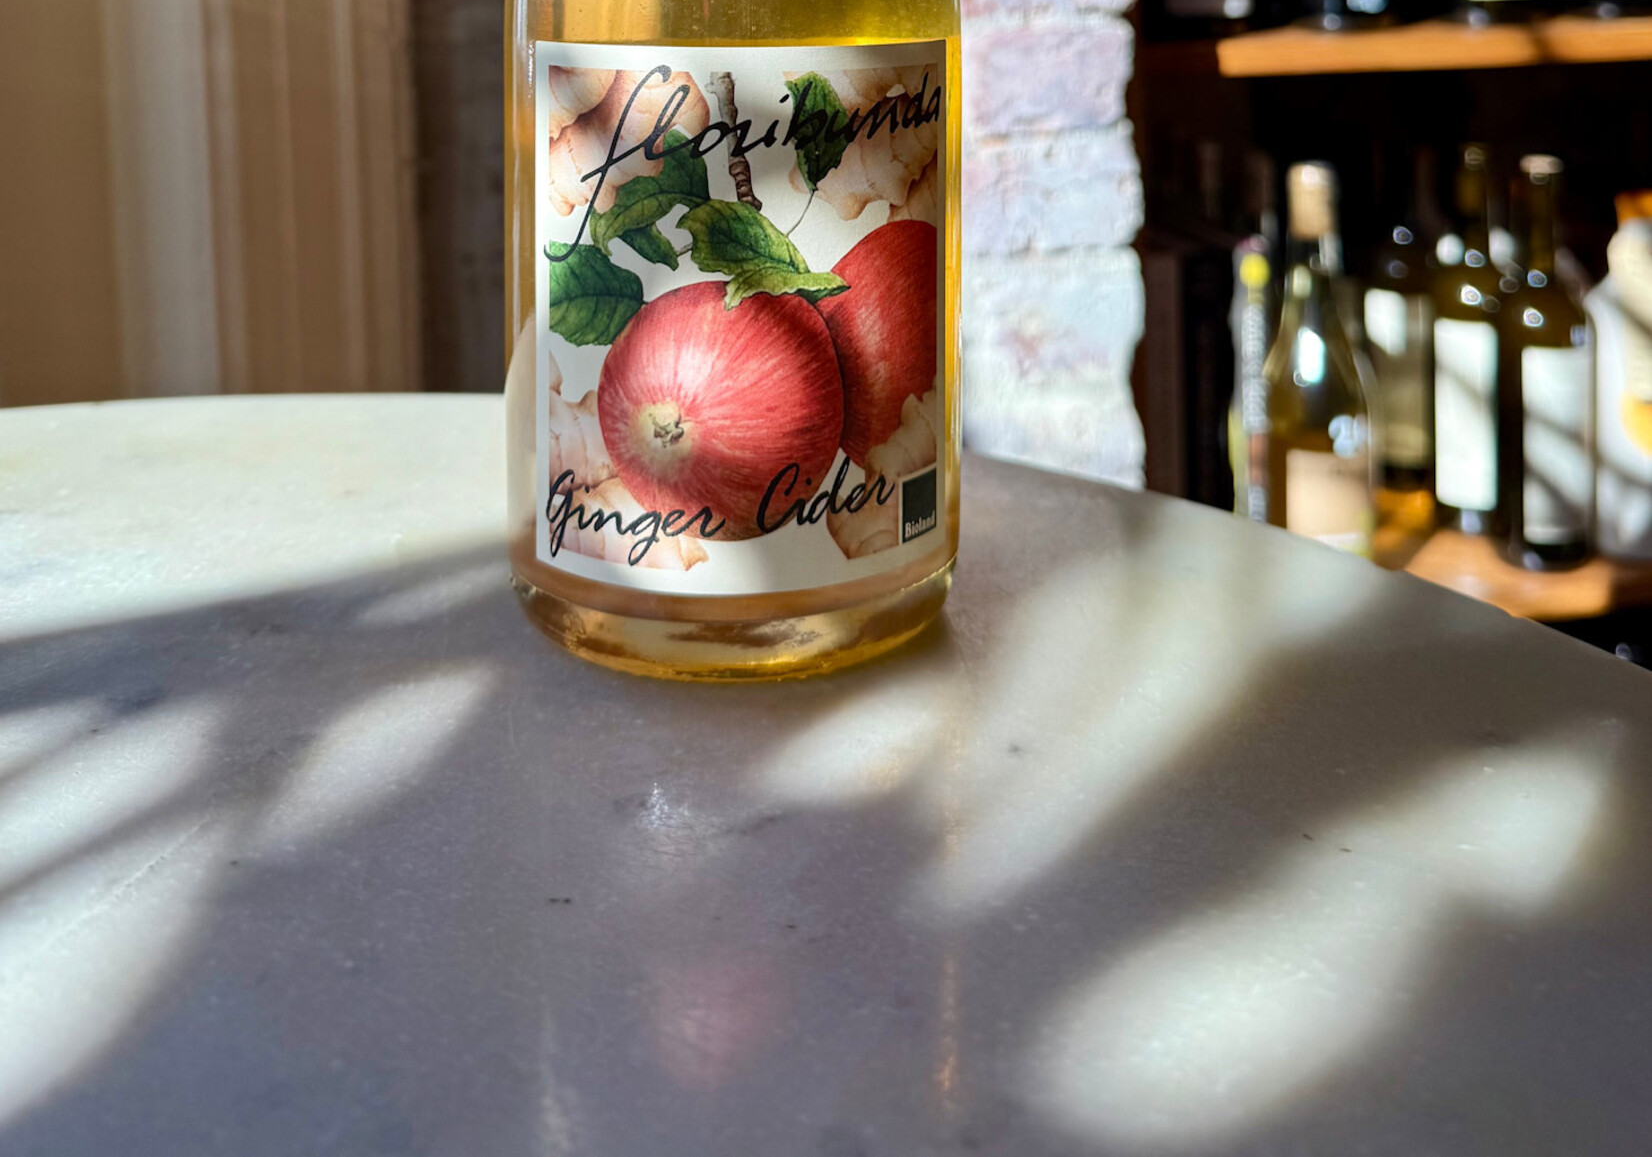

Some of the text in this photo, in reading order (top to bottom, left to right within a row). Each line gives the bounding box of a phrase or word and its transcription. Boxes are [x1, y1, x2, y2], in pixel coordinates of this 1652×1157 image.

[544, 64, 942, 262] floribunda
[545, 457, 895, 566] Ginger Cider
[904, 509, 936, 538] Bioland
